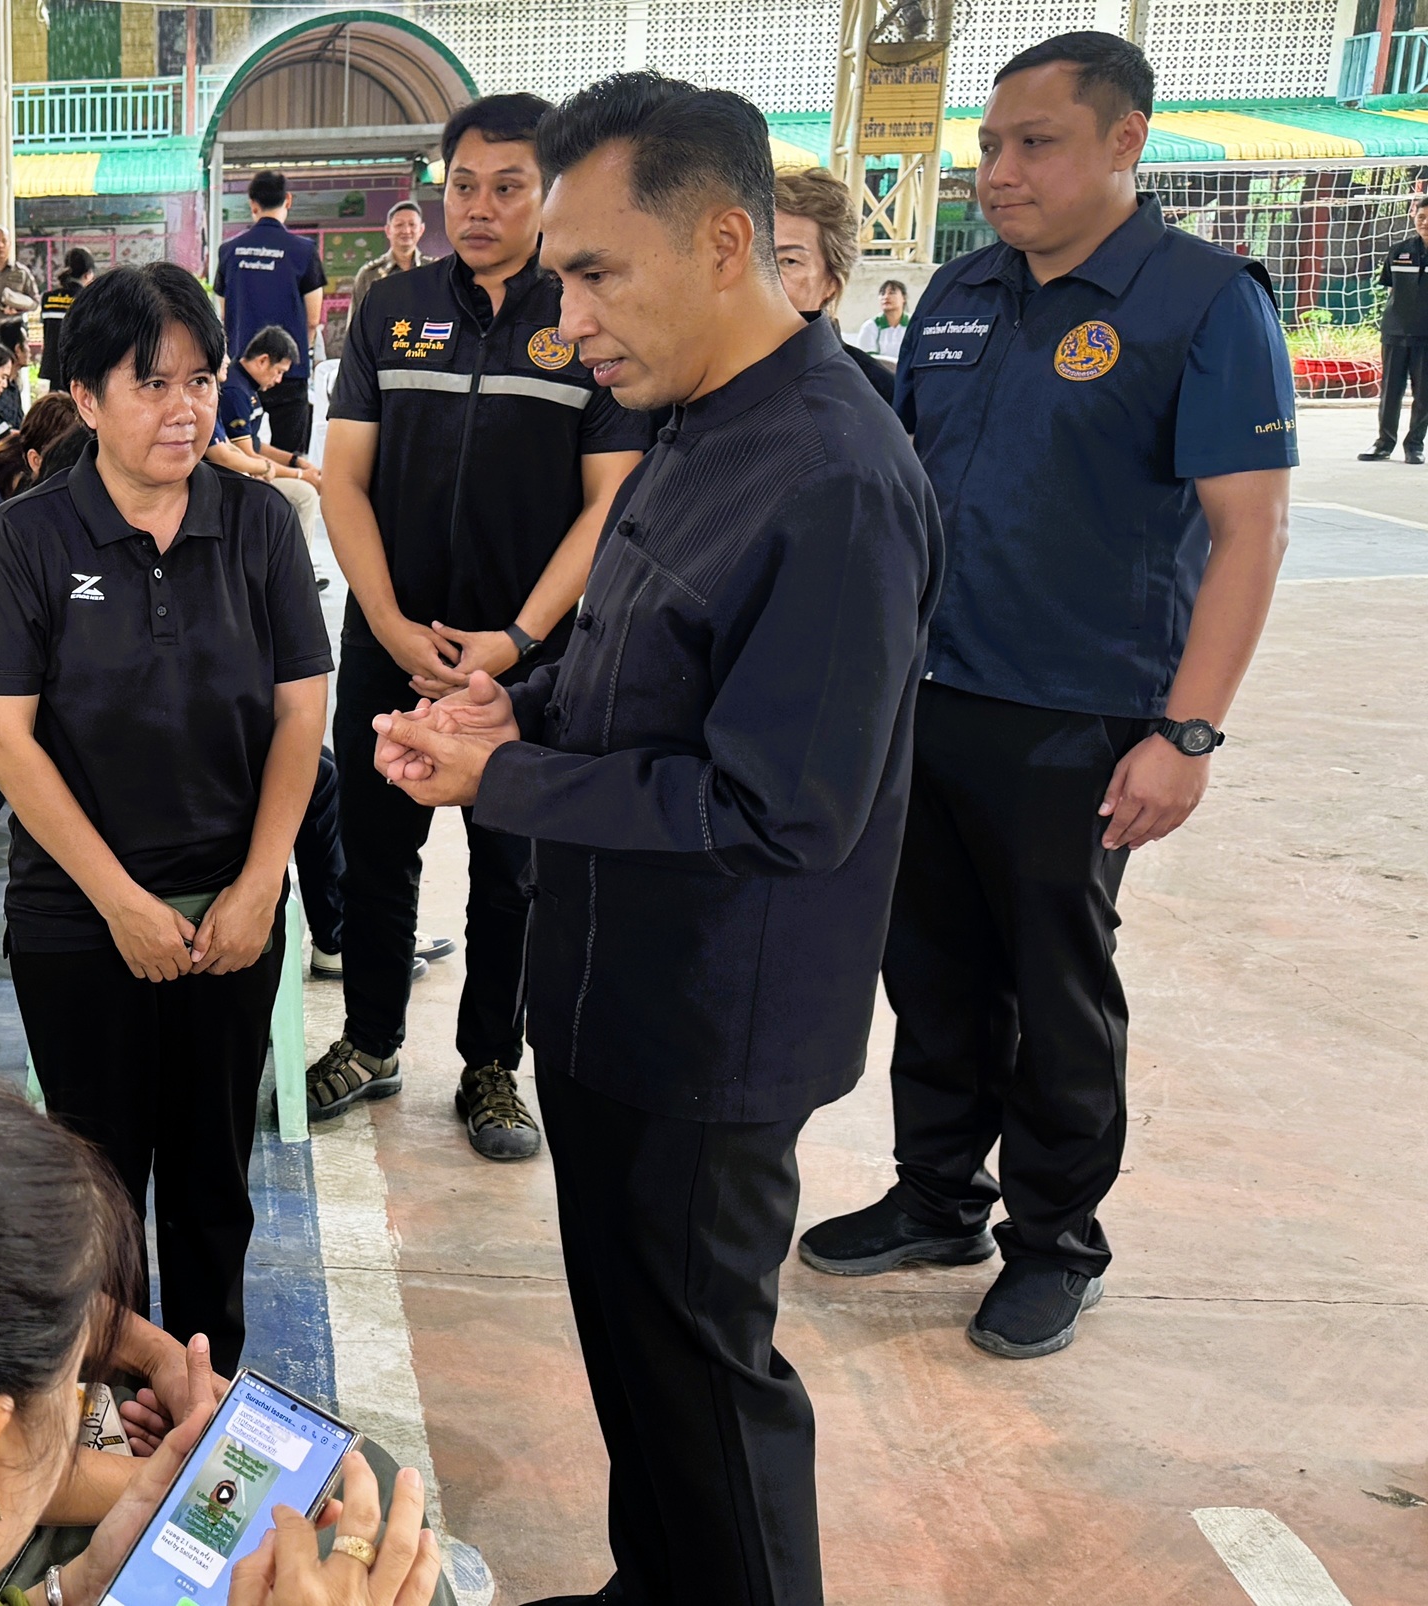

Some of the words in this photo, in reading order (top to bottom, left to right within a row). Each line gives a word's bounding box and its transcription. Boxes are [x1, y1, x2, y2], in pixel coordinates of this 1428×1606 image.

[405, 348, 426, 358] กำนัน
[929, 348, 963, 360] นายอำเภอ
